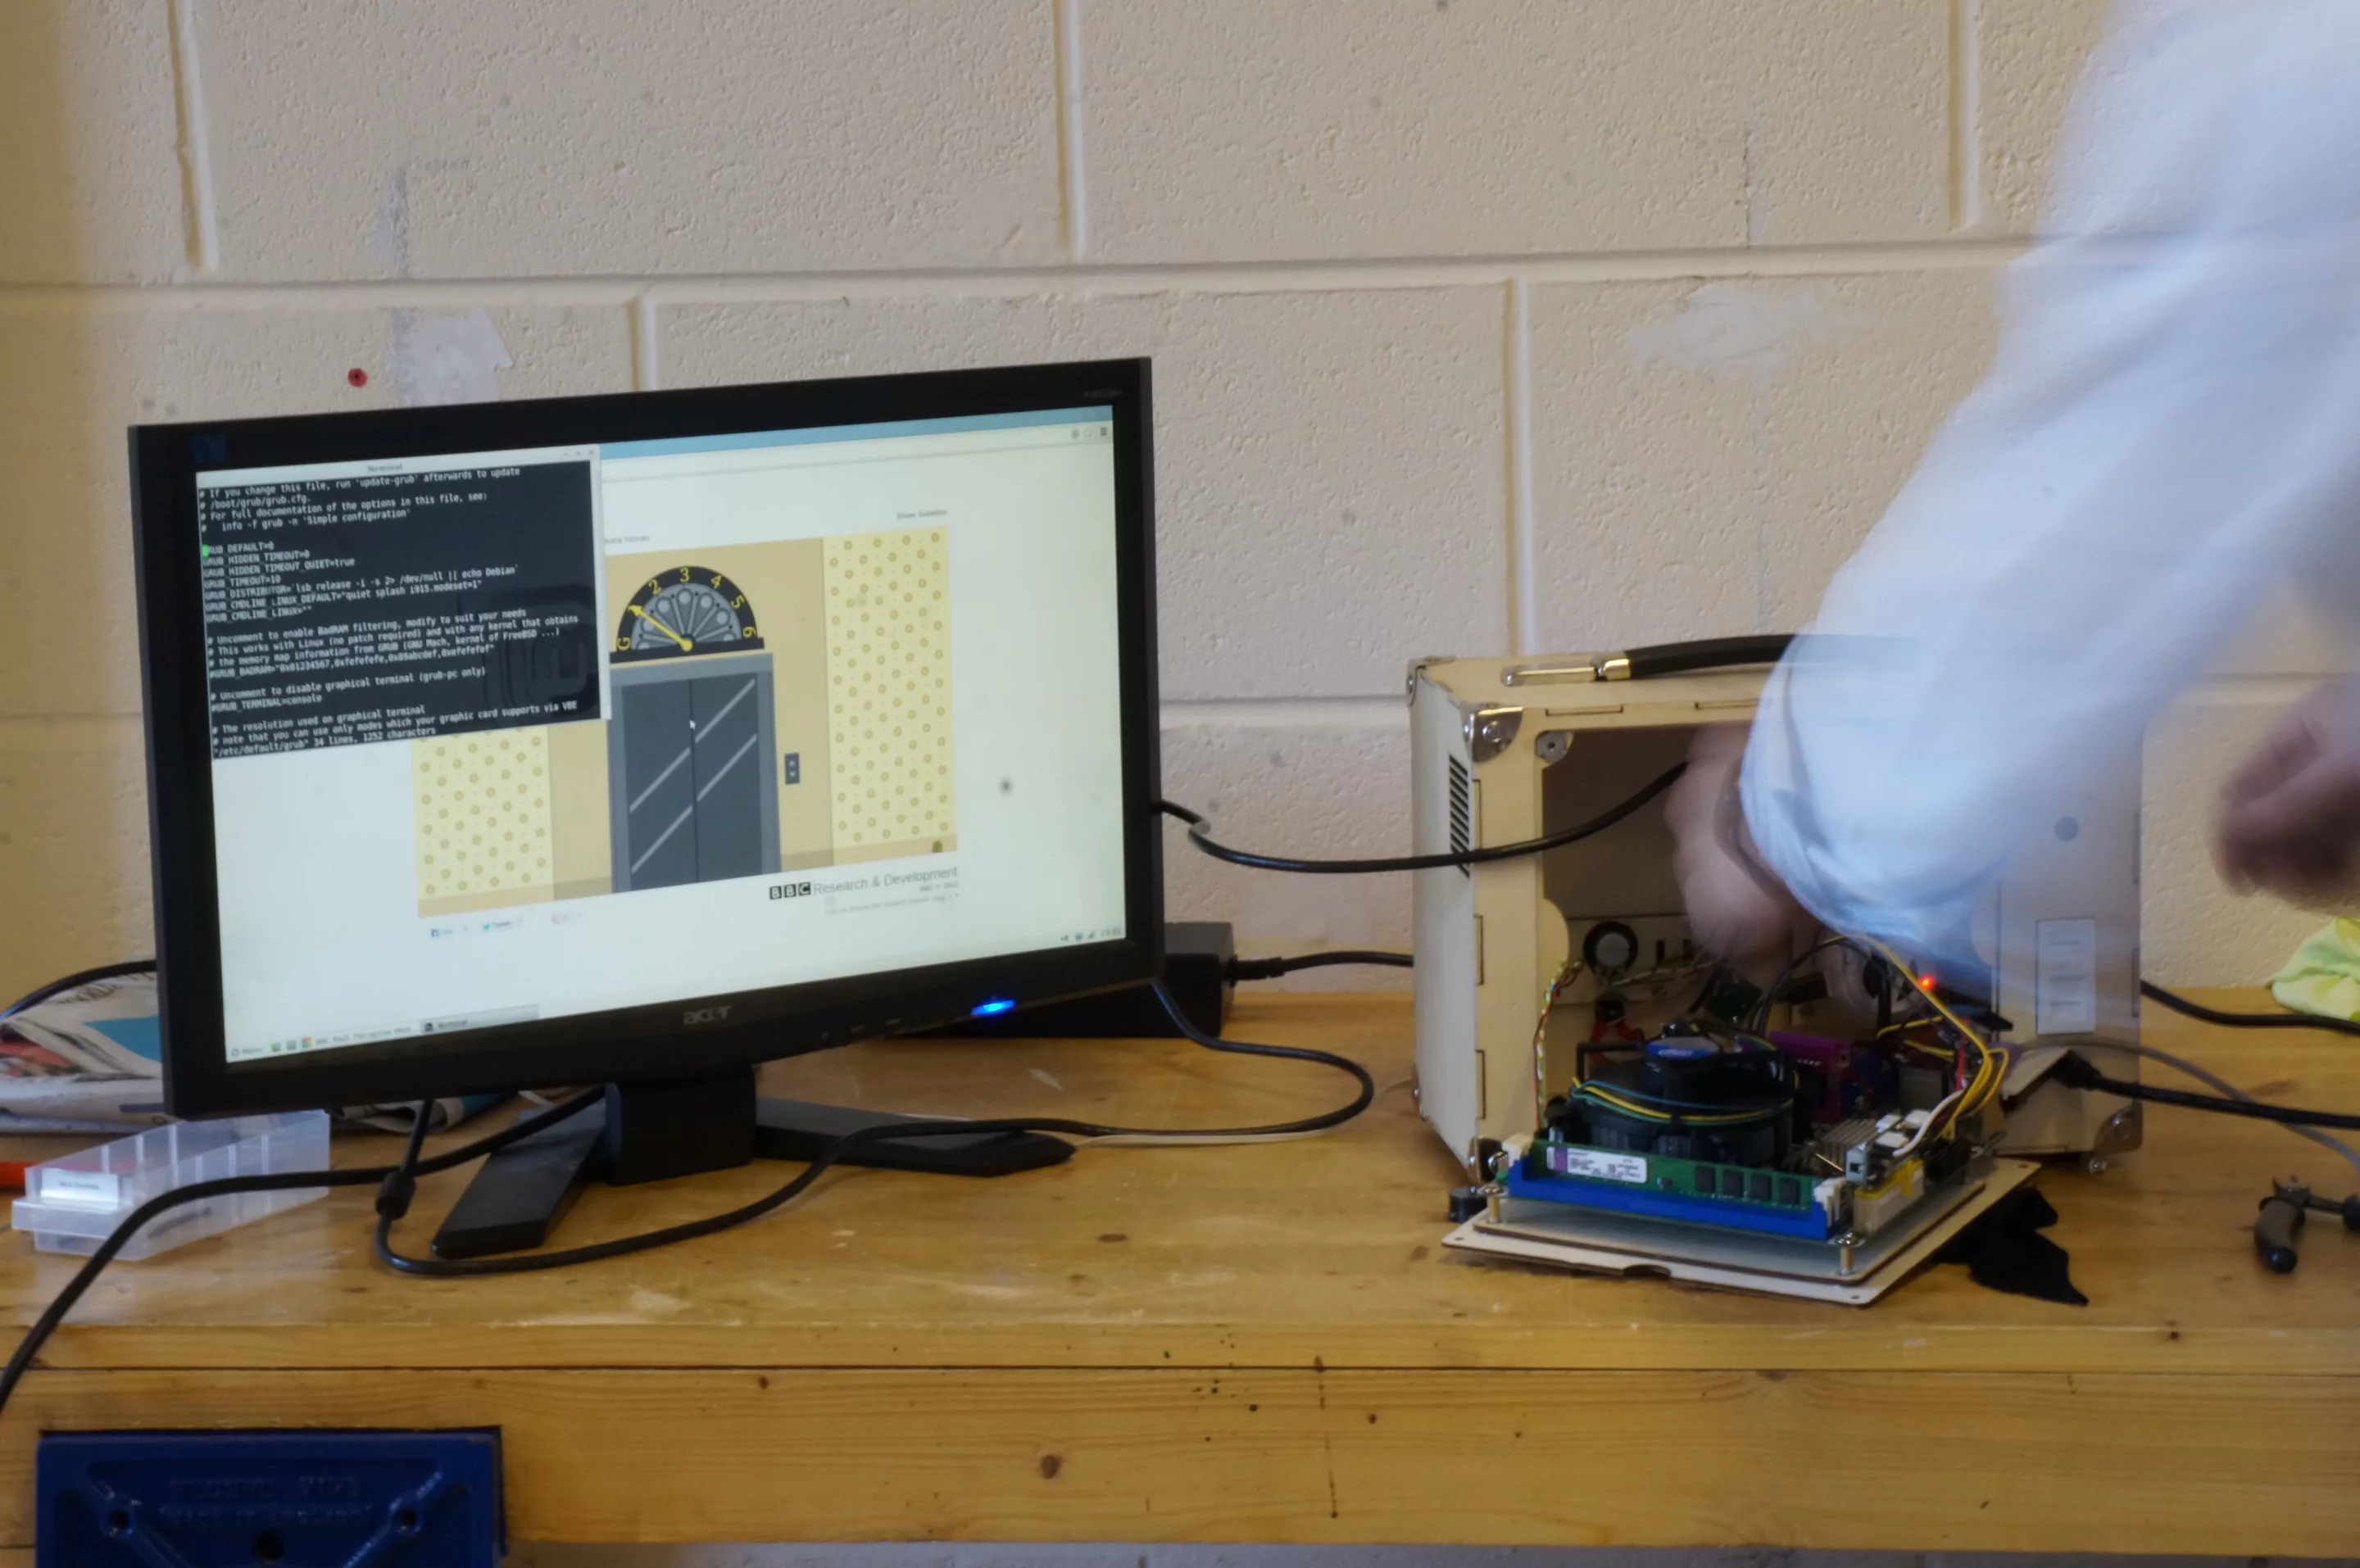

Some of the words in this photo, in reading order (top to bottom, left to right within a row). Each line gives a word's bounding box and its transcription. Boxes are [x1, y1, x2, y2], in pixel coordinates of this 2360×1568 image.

[210, 488, 220, 498] If
[225, 489, 241, 499] you
[245, 486, 276, 496] change
[280, 483, 302, 492] this
[306, 481, 331, 491] file,
[335, 481, 351, 489] run
[424, 471, 472, 483] afterwards
[477, 470, 487, 478] to
[491, 468, 520, 479] update
[211, 511, 227, 520] For
[231, 509, 252, 519] full
[256, 505, 322, 517] documentation
[327, 502, 337, 512] of
[342, 501, 357, 510] the
[361, 499, 396, 511] options
[401, 497, 411, 506] in
[415, 496, 435, 505] this
[439, 494, 464, 503] file,
[468, 493, 488, 501] see:
[221, 521, 243, 531] info
[262, 518, 283, 530] grub
[202, 541, 274, 555] RUB_DEFAULT=0
[375, 586, 406, 599] splash
[399, 572, 443, 585] /dev/null
[462, 569, 482, 578] echo
[648, 579, 662, 596] 2
[679, 567, 690, 583] 3
[710, 574, 723, 590] 4
[731, 595, 746, 610] 5
[742, 626, 756, 639] 6
[217, 632, 264, 644] Uncomment
[268, 631, 279, 640] to
[284, 628, 314, 638] enable
[318, 624, 348, 635] BadRAM
[352, 620, 402, 632] filtering,
[406, 617, 436, 628] modify
[440, 615, 450, 624] to
[455, 613, 474, 623] suit
[479, 613, 497, 623] your
[502, 609, 526, 619] needs
[218, 646, 239, 655] This
[243, 643, 270, 653] works
[274, 640, 294, 650] with
[299, 639, 324, 648] Linux
[329, 637, 344, 647] (no
[348, 632, 374, 646] patch
[378, 628, 422, 642] required)
[426, 627, 441, 637] and
[446, 624, 465, 635] with
[470, 624, 484, 633] any
[488, 619, 517, 631] kernel
[521, 618, 541, 628] that
[545, 615, 578, 625] obtains
[219, 657, 234, 667] the
[239, 655, 270, 664] memory
[275, 654, 290, 663] map
[294, 647, 349, 659] information
[354, 646, 374, 654] from
[378, 641, 398, 652] GRUB
[402, 639, 422, 651] (GNU
[427, 637, 452, 647] Mach,
[456, 633, 484, 645] kernel
[489, 632, 499, 641] of
[503, 629, 537, 640] FreeBSD
[220, 687, 266, 700] Uncomment
[271, 687, 282, 696] to
[286, 682, 321, 694] disable
[326, 678, 370, 692] graphical
[374, 673, 415, 685] terminal
[419, 670, 457, 682] (grub-pc
[462, 666, 486, 678] only)
[222, 724, 238, 734] The
[243, 719, 293, 732] resolution
[297, 715, 318, 726] used
[338, 709, 382, 724] graphical
[386, 705, 425, 717] terminal
[223, 735, 244, 745] note
[248, 732, 269, 742] that
[274, 732, 289, 741] you
[293, 729, 309, 737] can
[313, 727, 329, 736] use
[333, 723, 353, 734] only
[357, 721, 383, 731] modes
[387, 717, 411, 727] which
[416, 716, 436, 727] your
[440, 711, 474, 724] graphic
[478, 708, 497, 718] card
[502, 705, 540, 717] supports
[544, 702, 558, 712] via
[562, 700, 577, 709] VBE
[329, 736, 359, 745] lines,
[388, 727, 436, 739] characters
[769, 881, 811, 900] BBC
[813, 877, 869, 895] Research
[884, 867, 958, 886] Development
